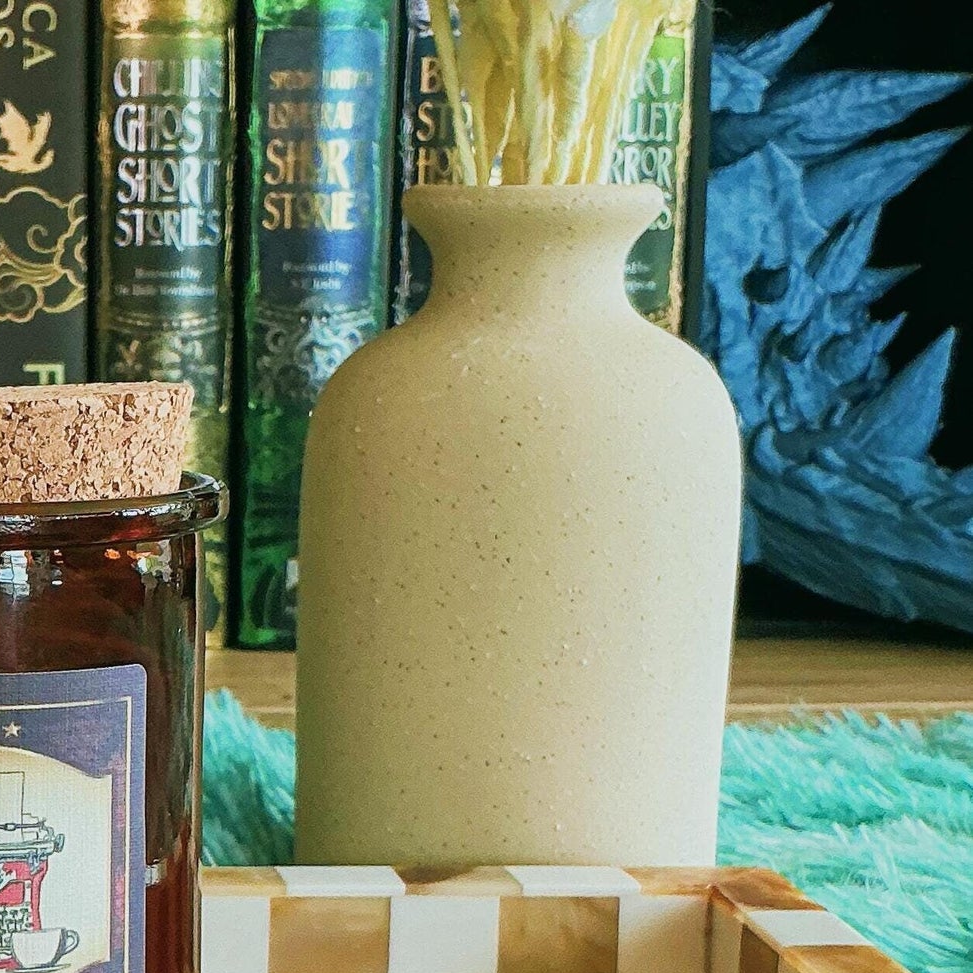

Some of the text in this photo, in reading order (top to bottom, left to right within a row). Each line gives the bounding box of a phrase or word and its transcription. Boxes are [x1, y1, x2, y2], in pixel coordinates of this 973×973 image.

[113, 101, 220, 153] GHOST
[117, 155, 221, 206] SHORT
[114, 204, 222, 253] STORIES
